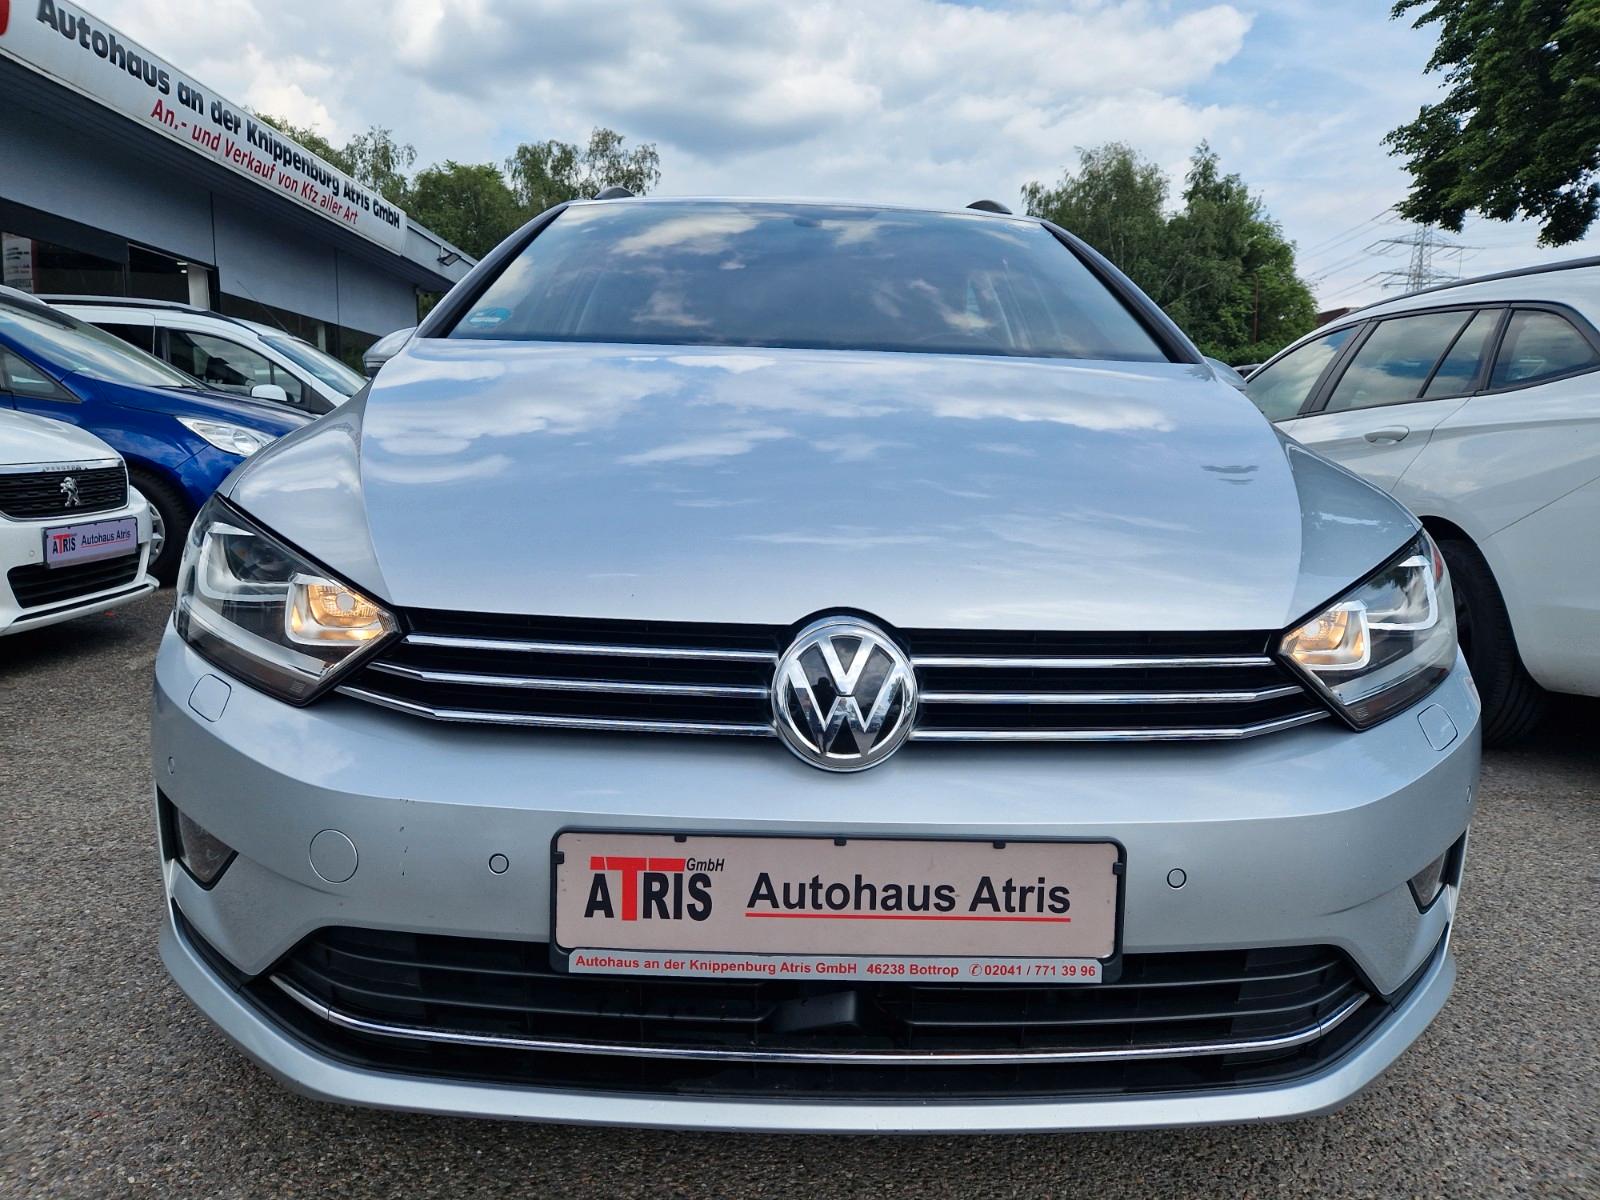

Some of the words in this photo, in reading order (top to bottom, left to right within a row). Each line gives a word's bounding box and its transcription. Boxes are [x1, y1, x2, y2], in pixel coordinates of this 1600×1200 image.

[36, 0, 170, 95] Autohaus
[177, 81, 204, 115] an
[210, 100, 241, 135] der
[246, 119, 339, 197] Knippenburg
[343, 180, 370, 211] Atris
[373, 200, 400, 229] GmbH
[191, 124, 221, 151] und
[224, 137, 276, 180] Verkauf
[278, 171, 298, 193] von
[300, 181, 319, 204] Kfz
[320, 194, 342, 216] aller
[343, 208, 359, 225] Art
[52, 533, 76, 554] ATRIS
[81, 533, 114, 546] Autohaus
[116, 530, 131, 540] Atris
[686, 857, 725, 873] GmbH
[584, 856, 713, 922] ATRIS
[747, 872, 956, 912] Autohaus
[968, 876, 1071, 914] Atris
[575, 955, 639, 969] Autohaus
[643, 960, 660, 970] an
[664, 958, 685, 971] der
[689, 959, 776, 975] Knippenburg
[780, 961, 811, 974] Atris
[815, 962, 857, 975] GmbH
[866, 963, 905, 975] 46238
[909, 963, 960, 978] Bottrop
[984, 965, 1022, 976] 02041
[1035, 965, 1056, 977] 771
[1061, 966, 1077, 977] 39
[1080, 966, 1096, 977] 96
